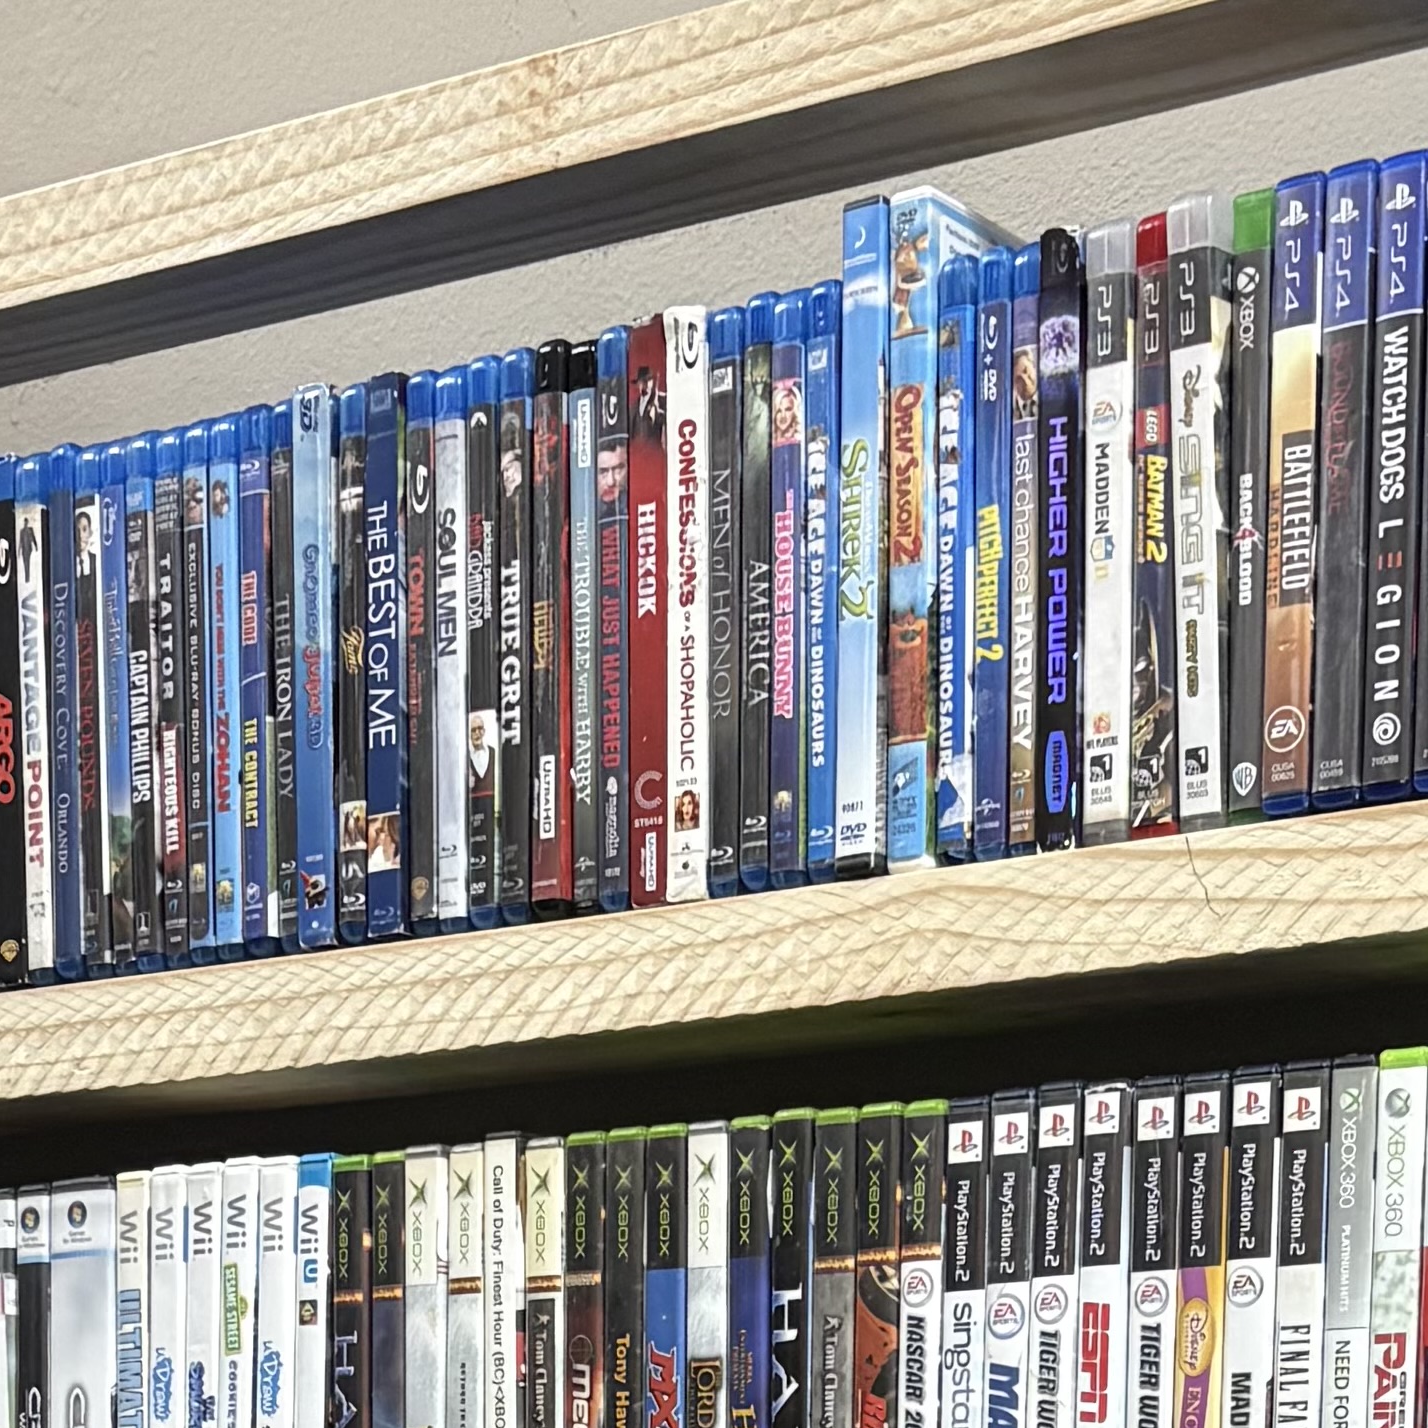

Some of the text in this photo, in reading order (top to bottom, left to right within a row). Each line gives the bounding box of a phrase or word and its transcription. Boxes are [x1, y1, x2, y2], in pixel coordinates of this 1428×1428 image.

[1382, 325, 1409, 425] WATCH
[1379, 426, 1406, 504] DOGS
[637, 501, 657, 618] HICKOK
[1047, 416, 1068, 705] HIGHER POWER
[1281, 444, 1312, 592] BATTLEFIELD
[367, 500, 396, 749] THE BEST OF ME
[680, 634, 695, 772] SHOPAHOLIC
[492, 1165, 504, 1195] Call
[491, 1217, 504, 1256] Duty:
[493, 1311, 504, 1347] Hour
[614, 1334, 630, 1385] Tony
[905, 1314, 926, 1404] NASCAR
[1079, 1302, 1111, 1424] ESPN
[1334, 1340, 1351, 1390] NEED
